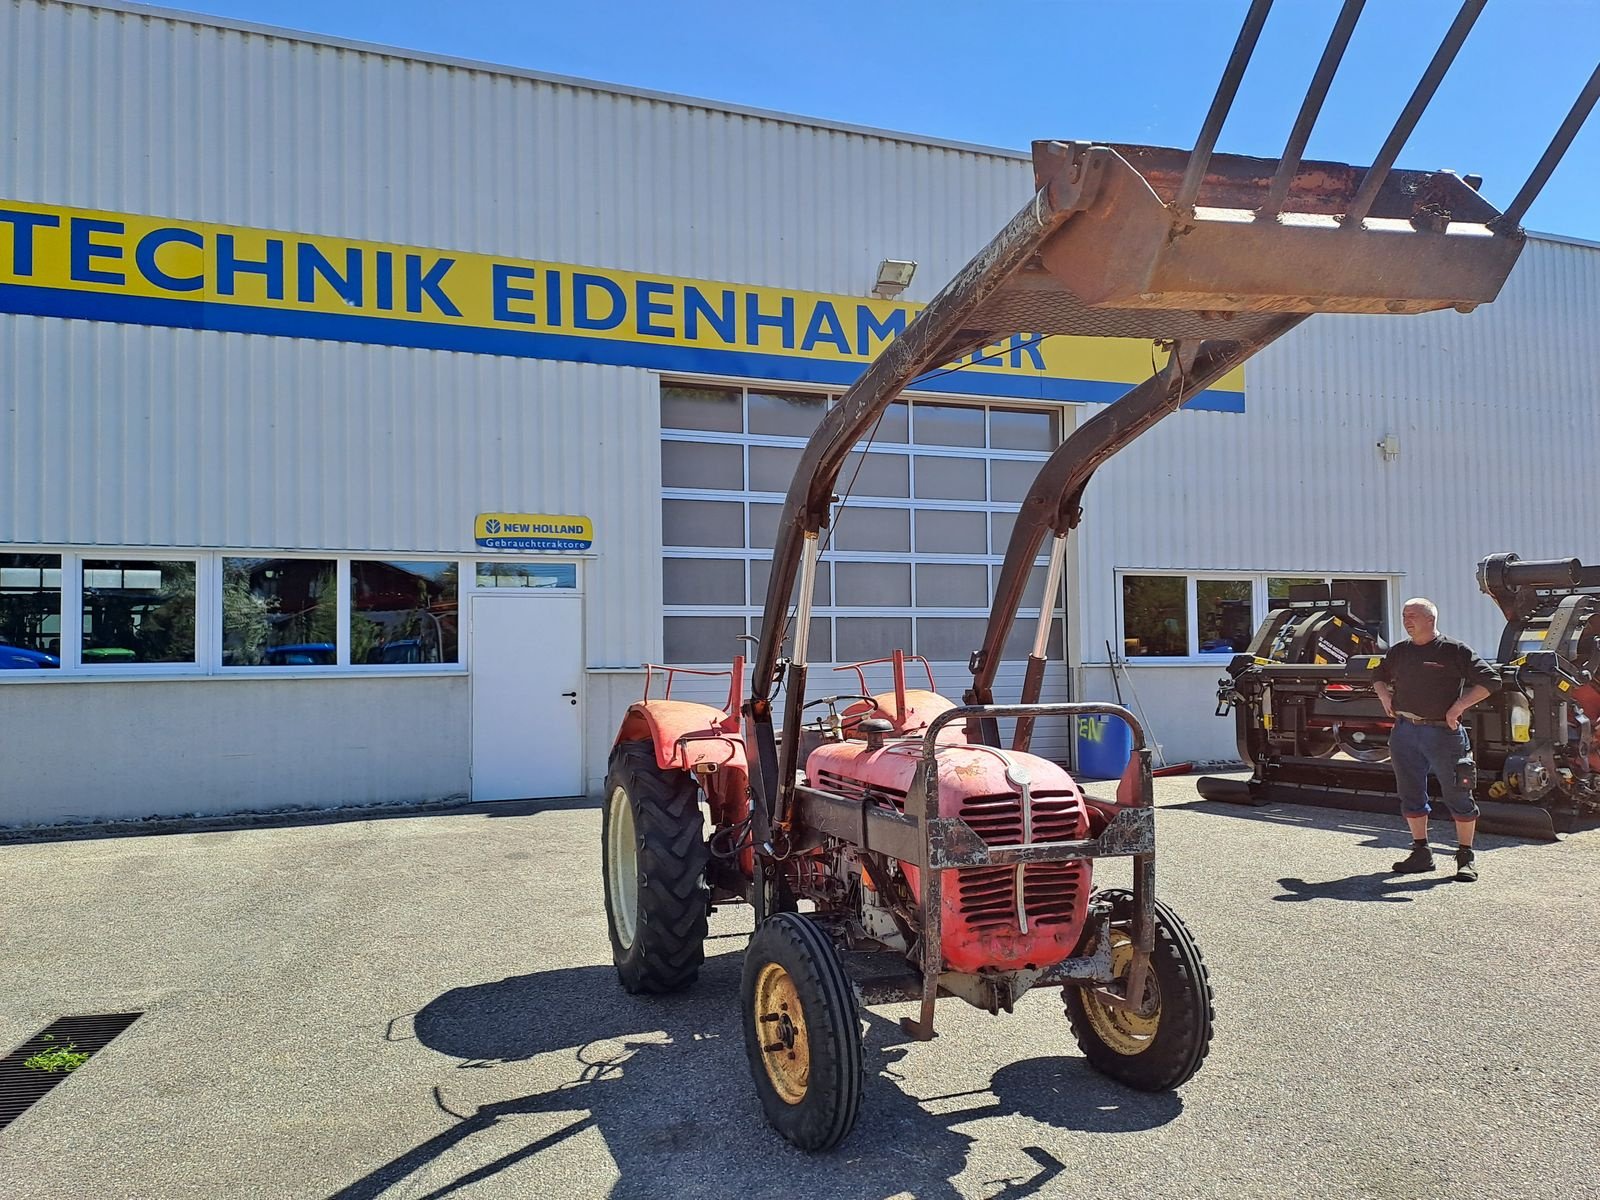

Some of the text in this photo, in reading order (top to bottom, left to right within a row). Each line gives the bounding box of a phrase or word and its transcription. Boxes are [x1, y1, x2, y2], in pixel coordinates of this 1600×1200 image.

[0, 209, 1048, 371] TECHNIK EIDENHAMER
[503, 523, 584, 534] NEW HOLLAND
[485, 538, 585, 549] Gebrauchttraktore
[1078, 717, 1105, 743] EN
